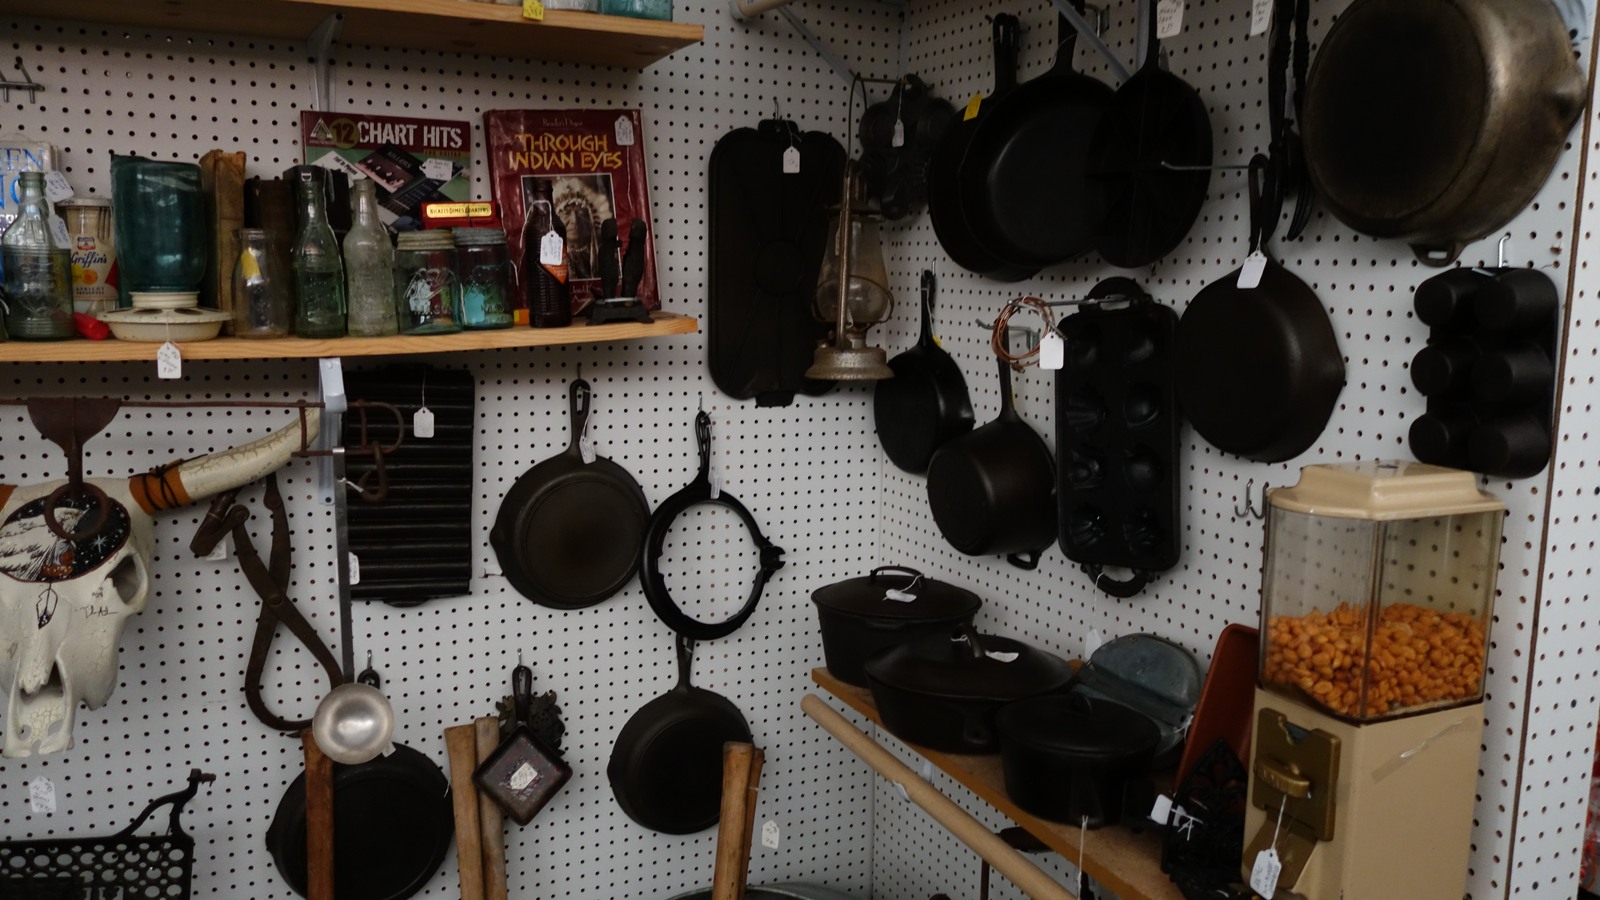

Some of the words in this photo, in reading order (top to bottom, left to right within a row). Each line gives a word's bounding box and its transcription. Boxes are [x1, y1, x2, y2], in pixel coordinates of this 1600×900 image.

[332, 122, 355, 144] 12
[358, 121, 418, 146] CHART
[423, 126, 463, 149] HITS
[515, 132, 608, 152] THROUGH
[508, 151, 575, 171] INDIAN
[580, 151, 623, 171] EYES
[70, 251, 107, 268] Griffin's
